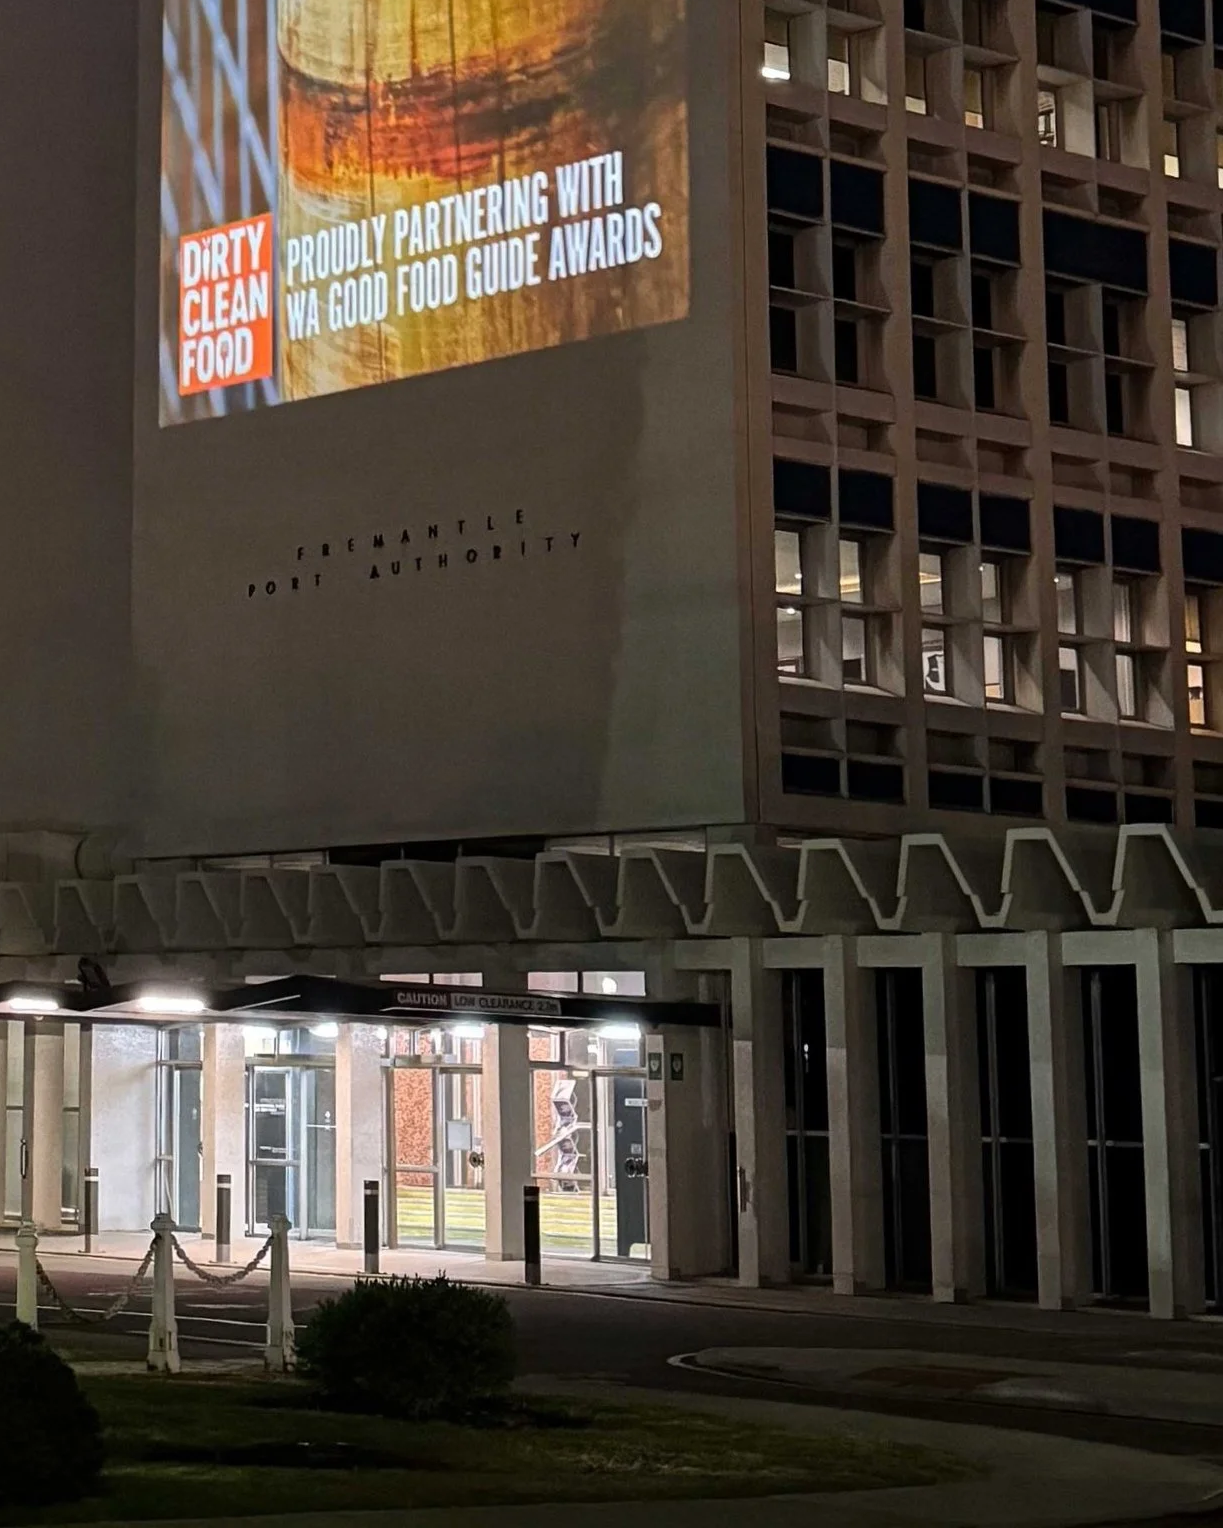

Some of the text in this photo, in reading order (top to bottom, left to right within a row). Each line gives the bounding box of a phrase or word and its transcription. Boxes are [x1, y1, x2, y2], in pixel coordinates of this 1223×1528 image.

[286, 150, 624, 288] PROUDLY PARTNERING WITH
[182, 269, 269, 338] CLEAN
[285, 201, 663, 342] WA GOOD FOOD GUIDE AWARDS
[181, 326, 254, 389] FOOD
[248, 531, 581, 598] PORT AUTHORITY
[296, 508, 525, 562] FREMANTLE
[396, 991, 448, 1007] CAUTION
[454, 995, 477, 1009] LOW
[478, 997, 535, 1012] CLEARANCE
